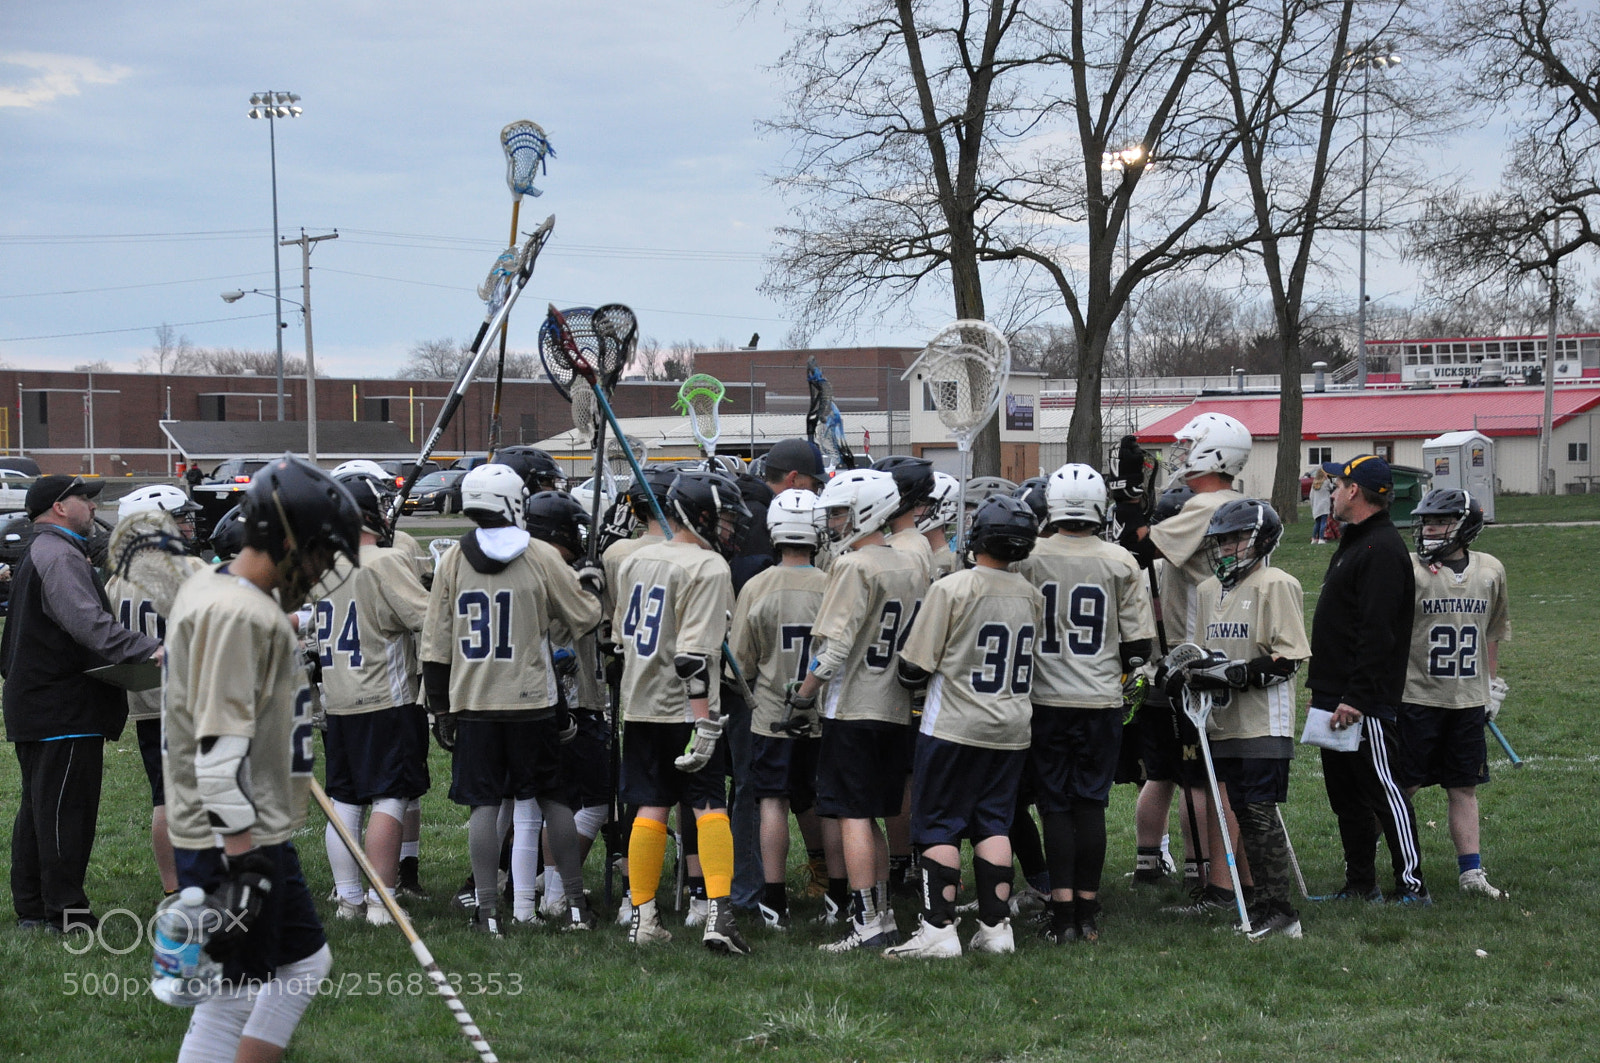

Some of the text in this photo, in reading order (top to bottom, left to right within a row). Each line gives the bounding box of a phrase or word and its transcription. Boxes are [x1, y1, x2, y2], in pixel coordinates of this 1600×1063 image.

[1434, 367, 1482, 377] VICKSBU
[604, 523, 629, 537] STX
[315, 598, 364, 669] 24
[456, 589, 515, 662] 31
[622, 582, 666, 659] 43
[1039, 581, 1108, 657] 19
[1422, 598, 1488, 614] MATTAWAN
[970, 622, 1035, 695] 36
[1429, 624, 1478, 678] 22
